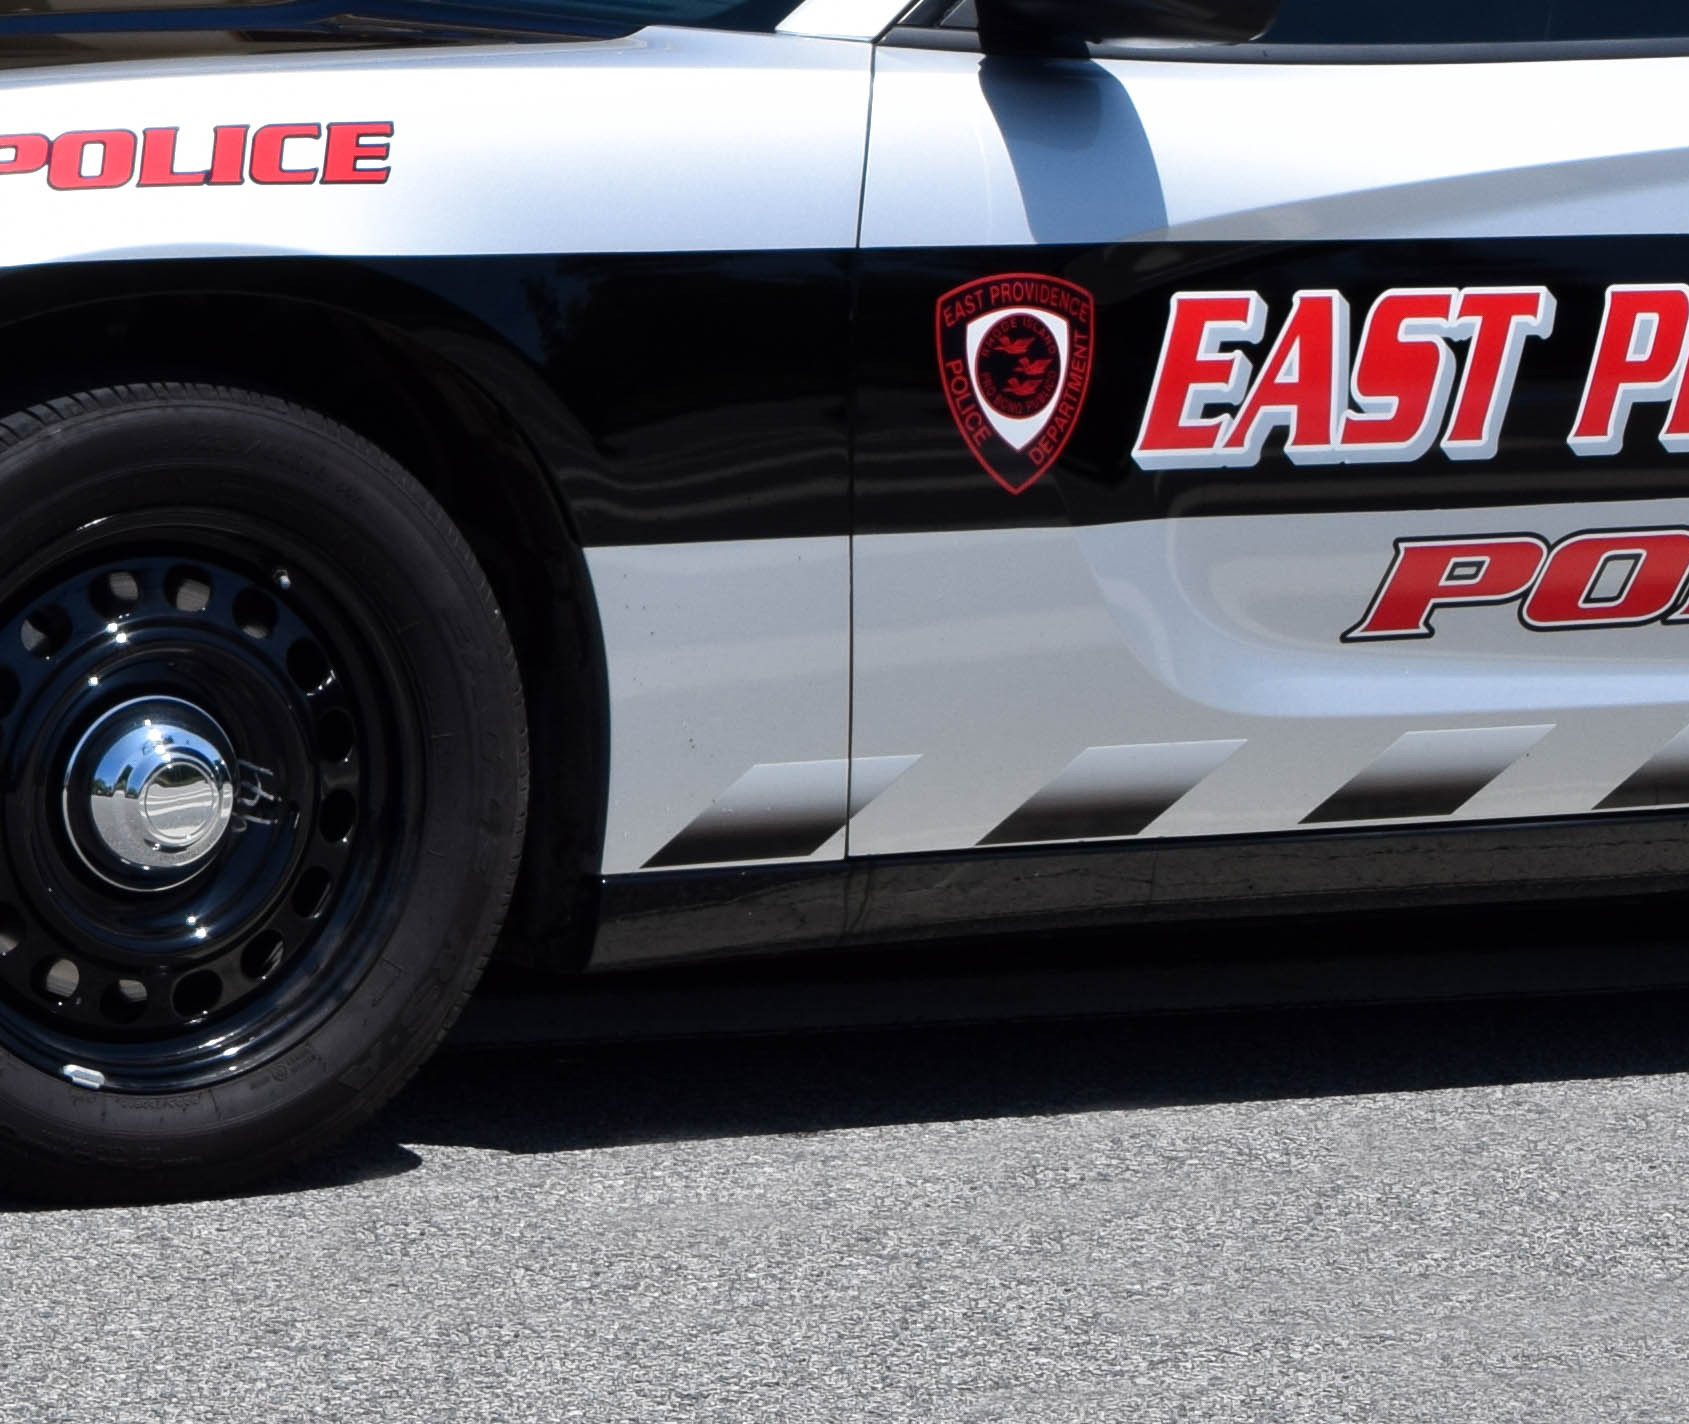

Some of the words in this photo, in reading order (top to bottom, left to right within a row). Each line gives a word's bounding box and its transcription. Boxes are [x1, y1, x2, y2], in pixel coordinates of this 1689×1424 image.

[943, 289, 986, 327] EAST
[990, 281, 1090, 323] PROVIDENCE
[945, 359, 993, 448] POLICE
[1027, 328, 1089, 466] DEPARTMENT
[1131, 286, 1560, 471] EAST
